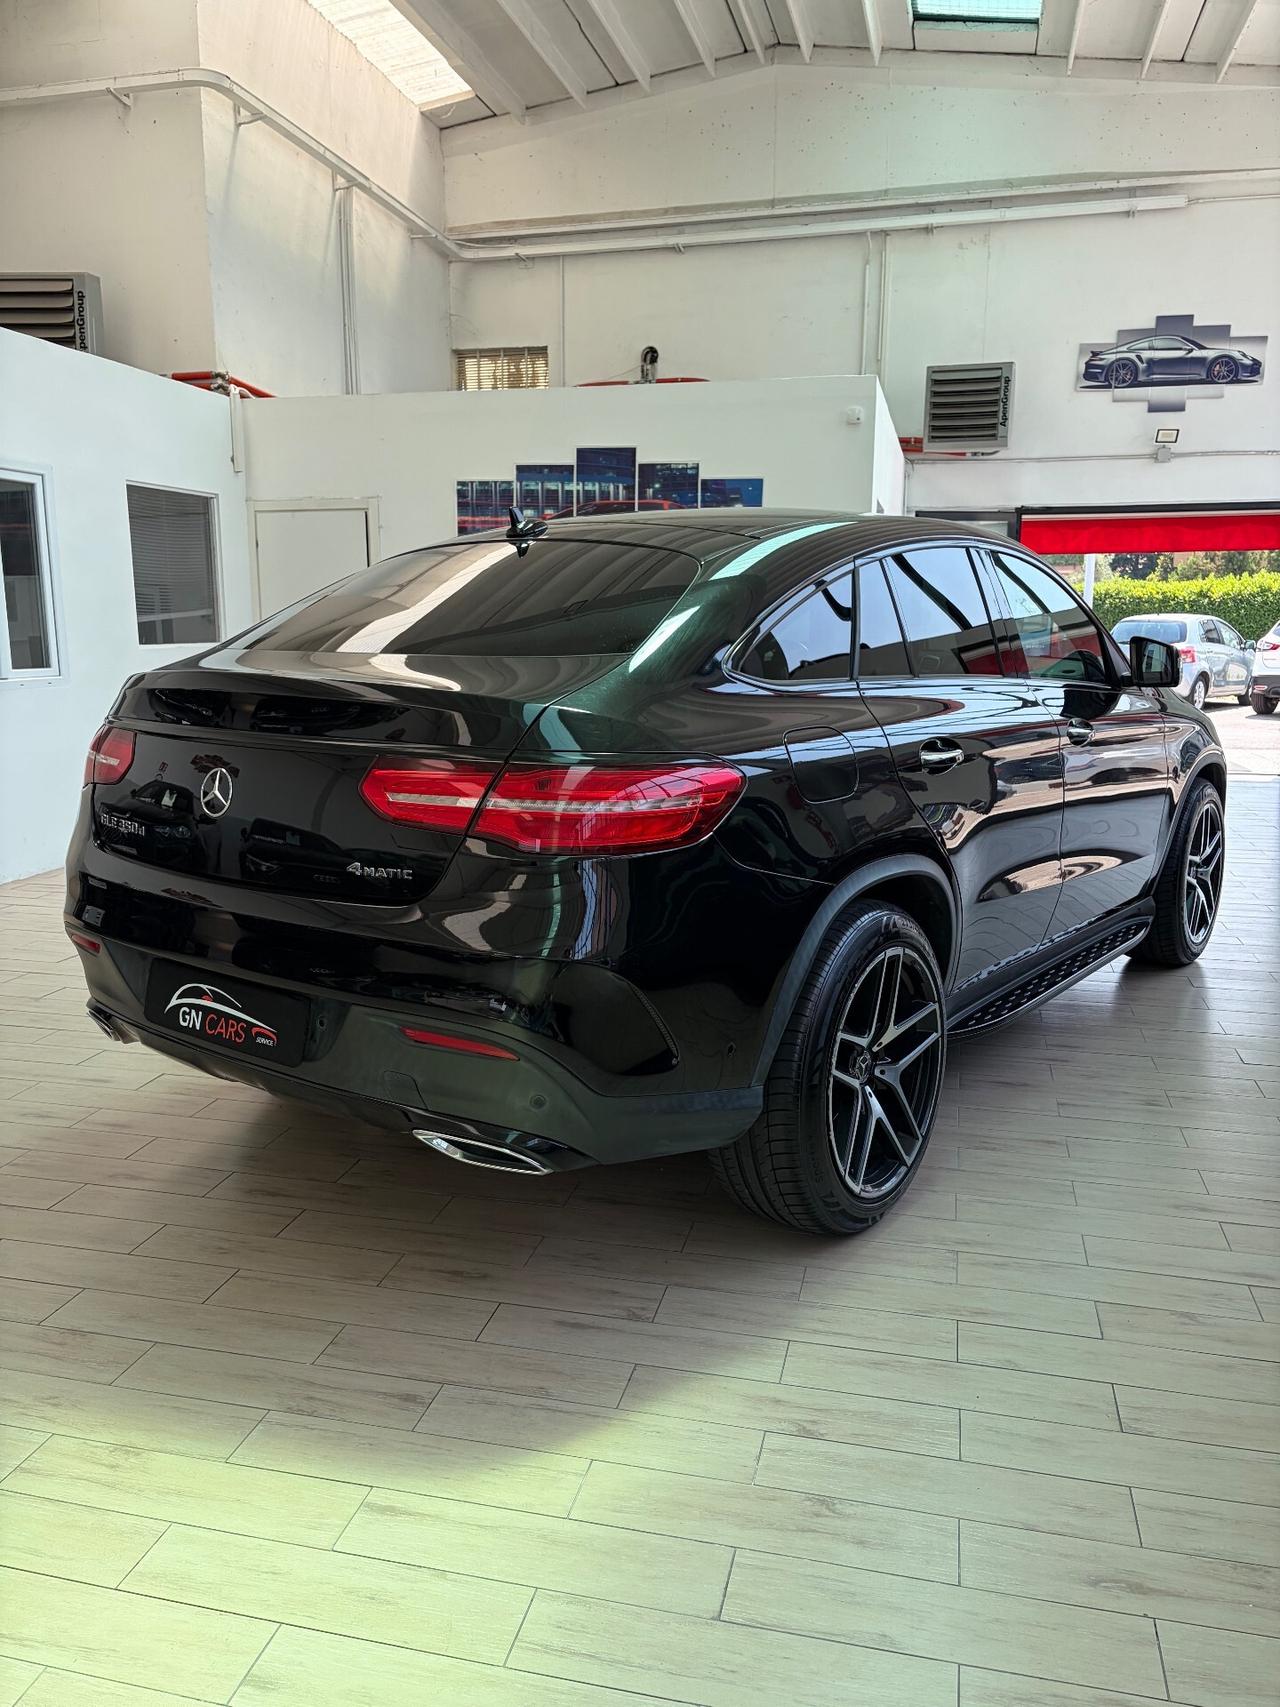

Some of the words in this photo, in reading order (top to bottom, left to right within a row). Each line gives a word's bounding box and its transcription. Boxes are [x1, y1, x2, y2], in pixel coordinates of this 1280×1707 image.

[76, 290, 88, 351] penGroup
[1000, 376, 1011, 427] ApenGroup
[346, 861, 413, 880] 4MATIC
[179, 1006, 202, 1031] GN
[205, 1013, 247, 1043] CARS
[255, 1036, 274, 1047] SERVICE
